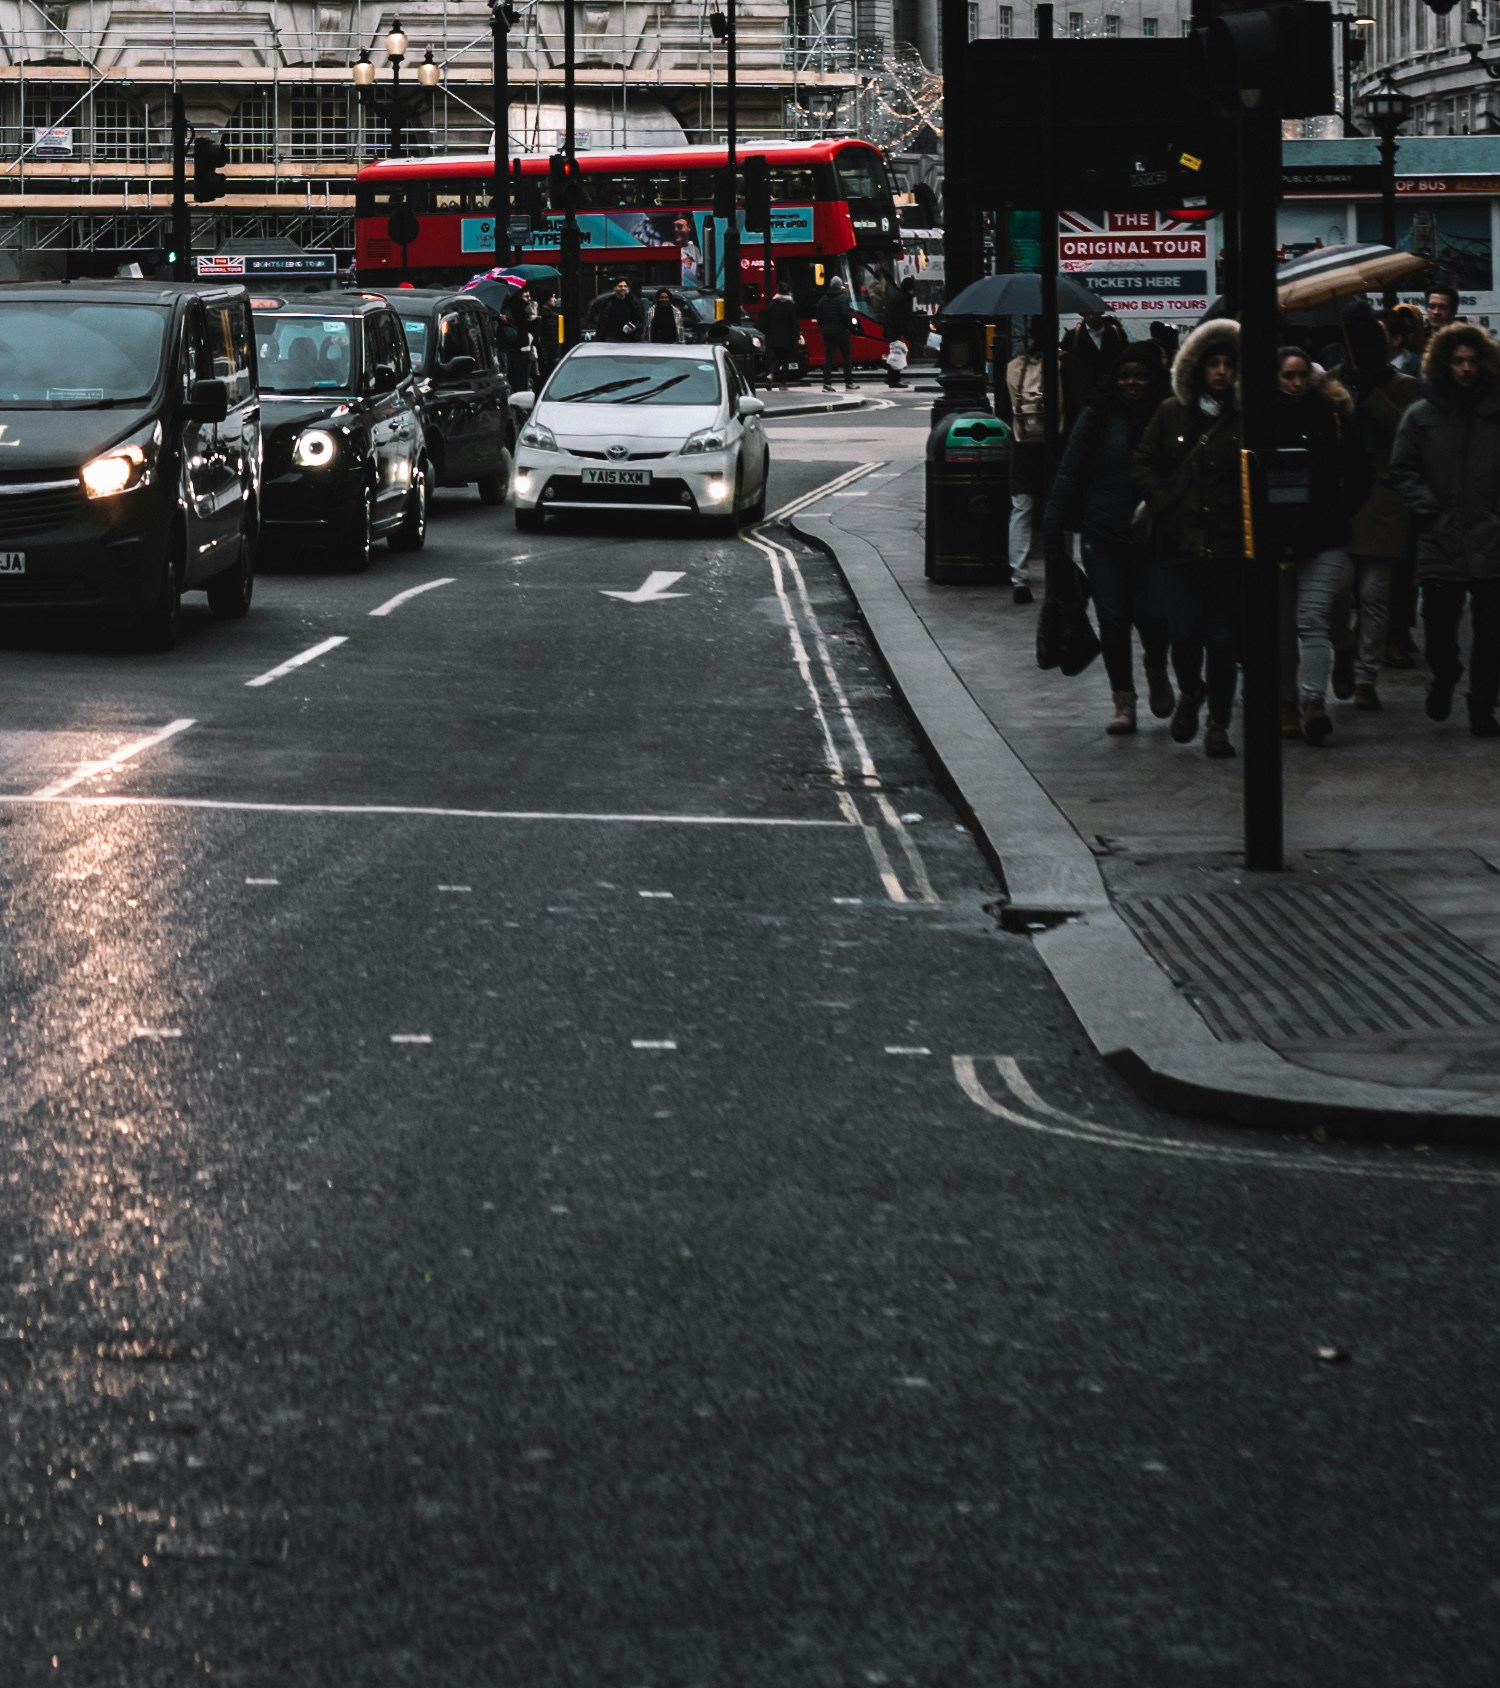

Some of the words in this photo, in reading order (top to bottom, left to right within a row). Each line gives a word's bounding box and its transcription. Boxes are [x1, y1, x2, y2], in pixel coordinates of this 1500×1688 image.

[1281, 175, 1313, 184] PUBLIC
[1315, 174, 1352, 183] SUBWAY
[1418, 180, 1447, 191] BUS
[1114, 214, 1149, 226] THE
[1064, 242, 1149, 255] ORIGINAL
[1152, 240, 1202, 253] TOUR
[1086, 277, 1143, 288] TICKETS
[1145, 276, 1181, 288] HERE
[1141, 300, 1164, 310] BUS
[1167, 299, 1207, 310] TOURS
[589, 470, 616, 483] YA15
[619, 471, 643, 483] KXM
